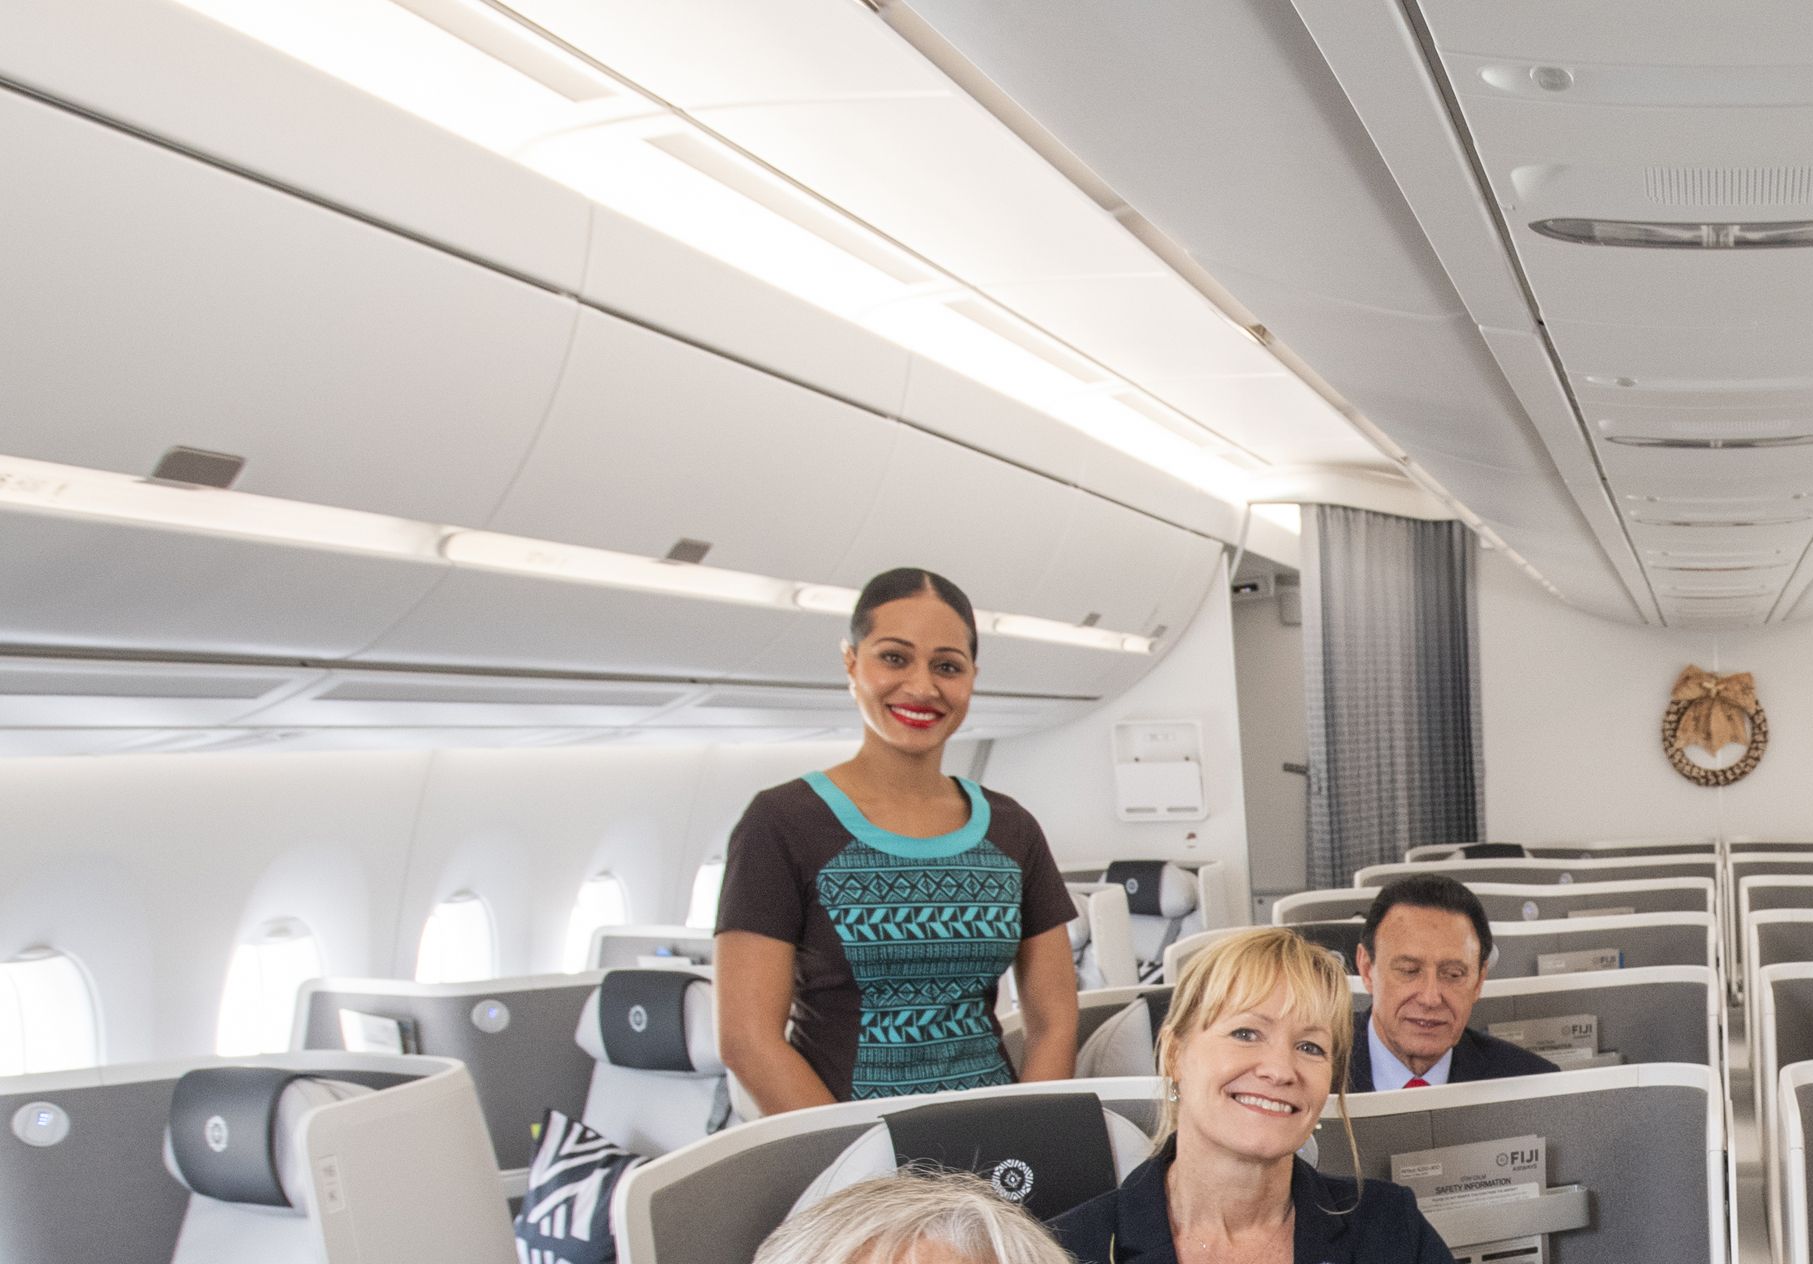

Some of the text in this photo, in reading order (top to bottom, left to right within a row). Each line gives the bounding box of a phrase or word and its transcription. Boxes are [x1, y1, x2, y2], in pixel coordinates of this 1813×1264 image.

[1571, 1024, 1593, 1034] FIJI
[1510, 1149, 1539, 1165] FIJI
[1435, 1183, 1463, 1195] SAFETY
[1464, 1177, 1512, 1191] INFORMATION
